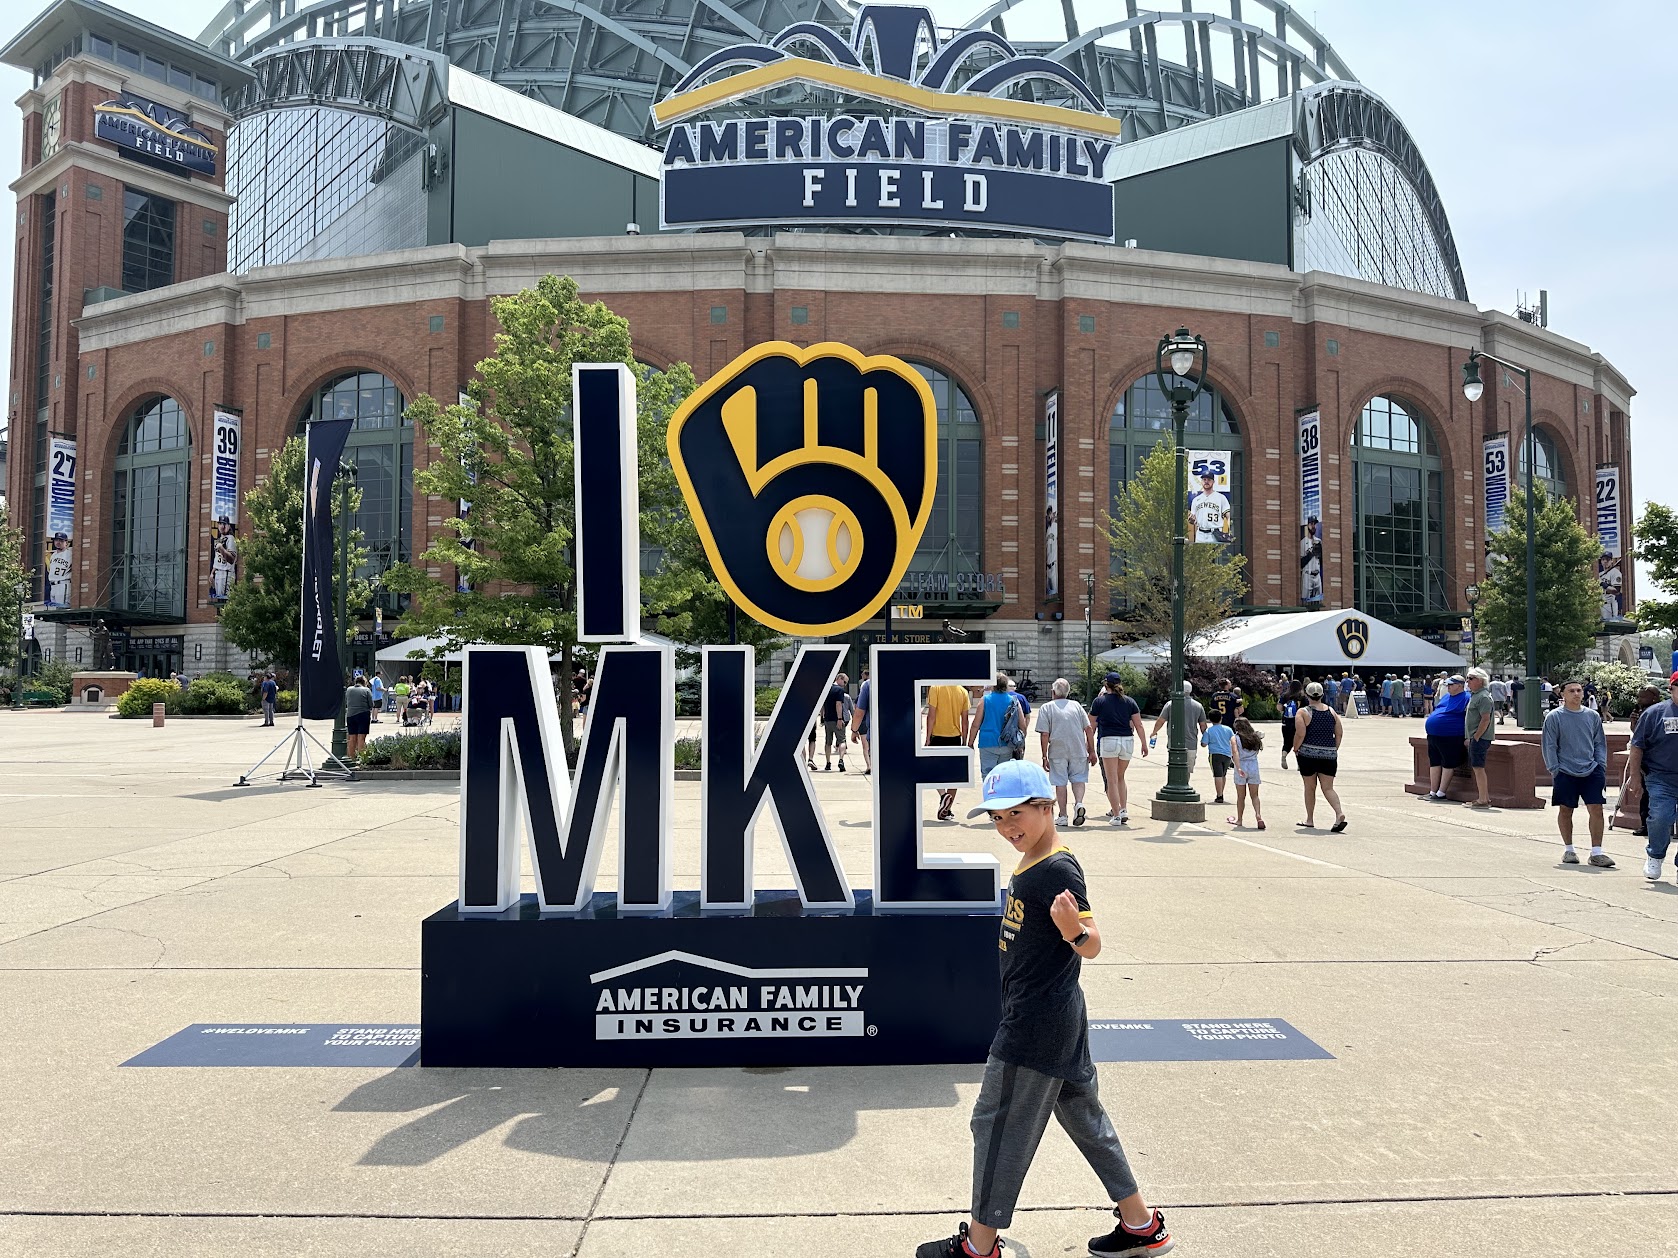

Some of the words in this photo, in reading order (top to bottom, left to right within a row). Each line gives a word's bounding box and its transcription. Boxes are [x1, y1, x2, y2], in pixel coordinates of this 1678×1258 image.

[99, 113, 168, 146] AMERICAN
[167, 137, 217, 161] FAMILY
[136, 137, 183, 162] FIELD
[663, 117, 927, 166] AMERICAN
[947, 130, 1114, 179] FAMILY
[801, 168, 989, 212] FIELD
[217, 426, 238, 455] 39
[1047, 410, 1056, 443] 11
[1301, 424, 1319, 454] 38
[52, 450, 76, 479] 27
[1047, 441, 1056, 503] TELLEZ
[1191, 459, 1226, 476] 53
[1485, 450, 1506, 474] 53
[215, 455, 237, 517] BURNES
[1302, 452, 1320, 521] WILLIAMS
[1597, 478, 1616, 503] 22
[49, 478, 76, 533] ADAMES
[572, 362, 639, 643] I
[1207, 513, 1219, 522] 53
[1597, 503, 1618, 549] YELICH
[54, 567, 67, 577] 27
[909, 572, 949, 592] TEAM
[956, 572, 1003, 593] STORE
[897, 605, 923, 619] TM
[876, 634, 899, 643] TEM
[904, 634, 931, 643] STORE
[1218, 701, 1227, 714] 5
[458, 643, 1001, 913] MKE
[986, 773, 1001, 795] T
[595, 986, 748, 1012] AMERICAN
[760, 985, 864, 1009] FAMILY
[617, 1016, 843, 1034] INSURANCE
